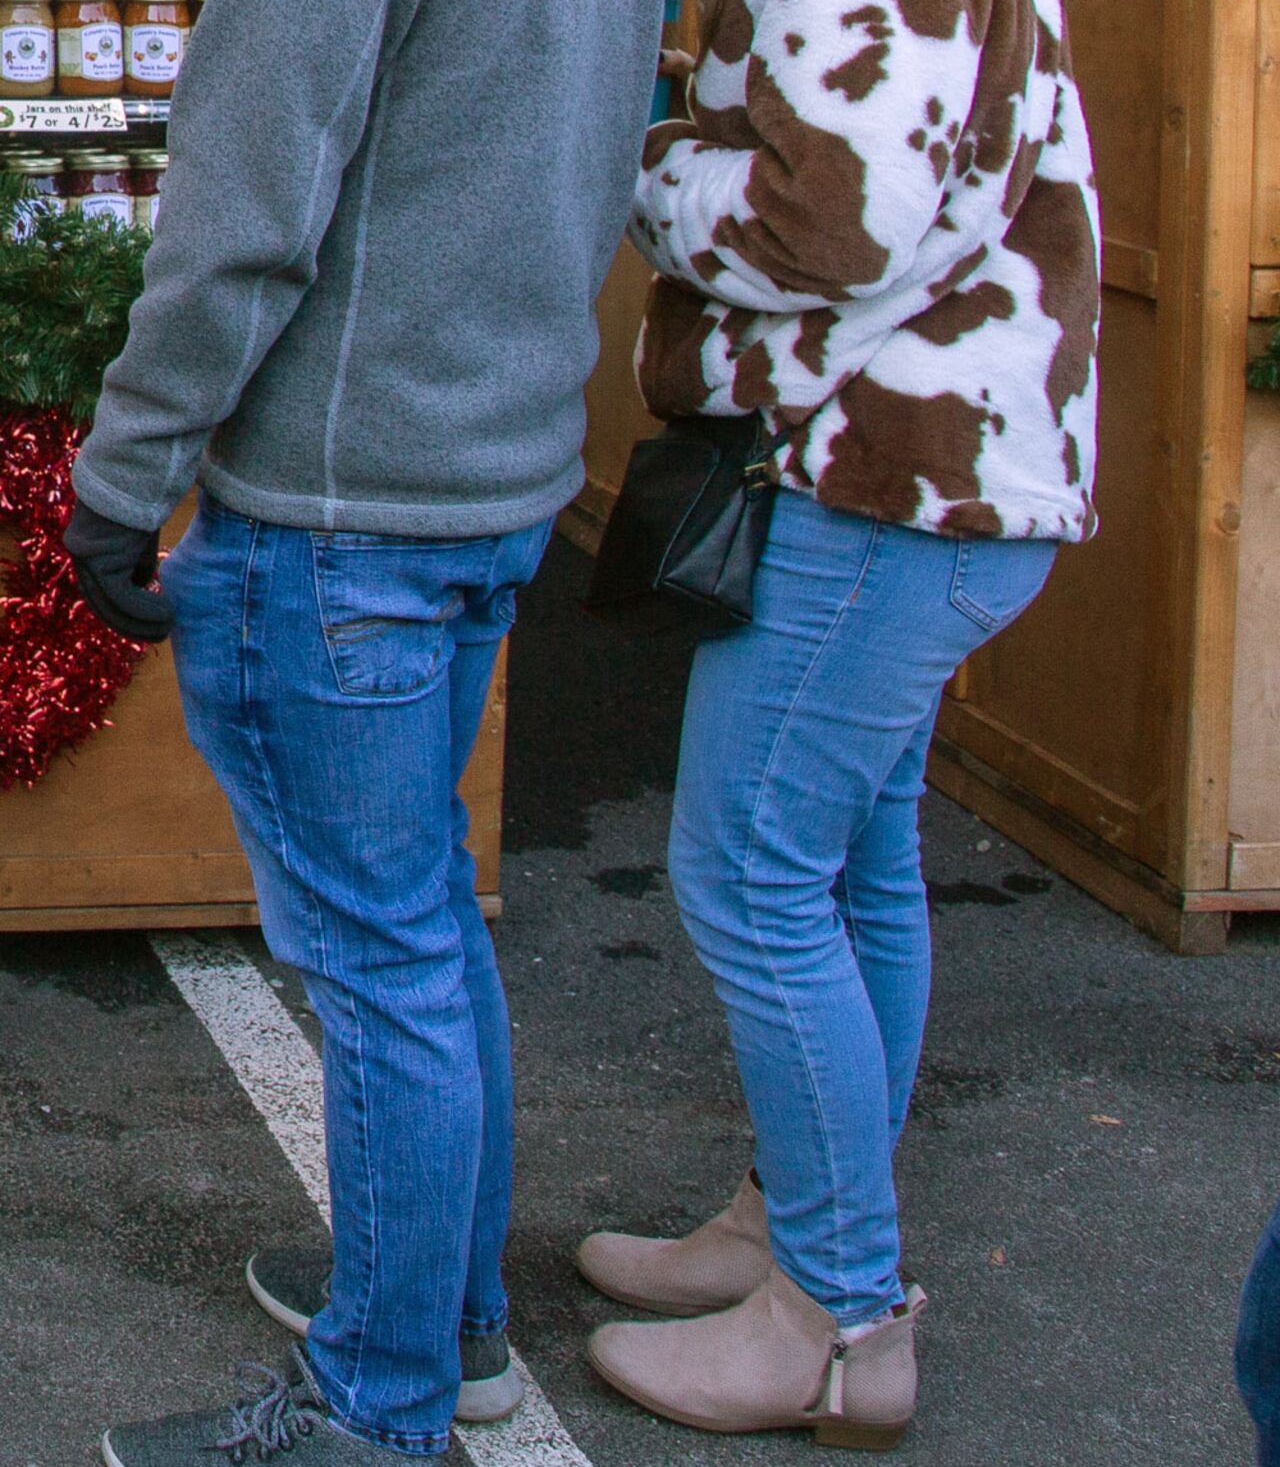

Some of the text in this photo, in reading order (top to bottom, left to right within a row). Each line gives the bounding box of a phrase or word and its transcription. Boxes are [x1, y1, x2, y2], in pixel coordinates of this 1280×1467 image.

[26, 104, 46, 114] Jars
[49, 106, 62, 114] on
[64, 103, 84, 113] this
[19, 114, 38, 129] $7
[44, 118, 58, 127] or
